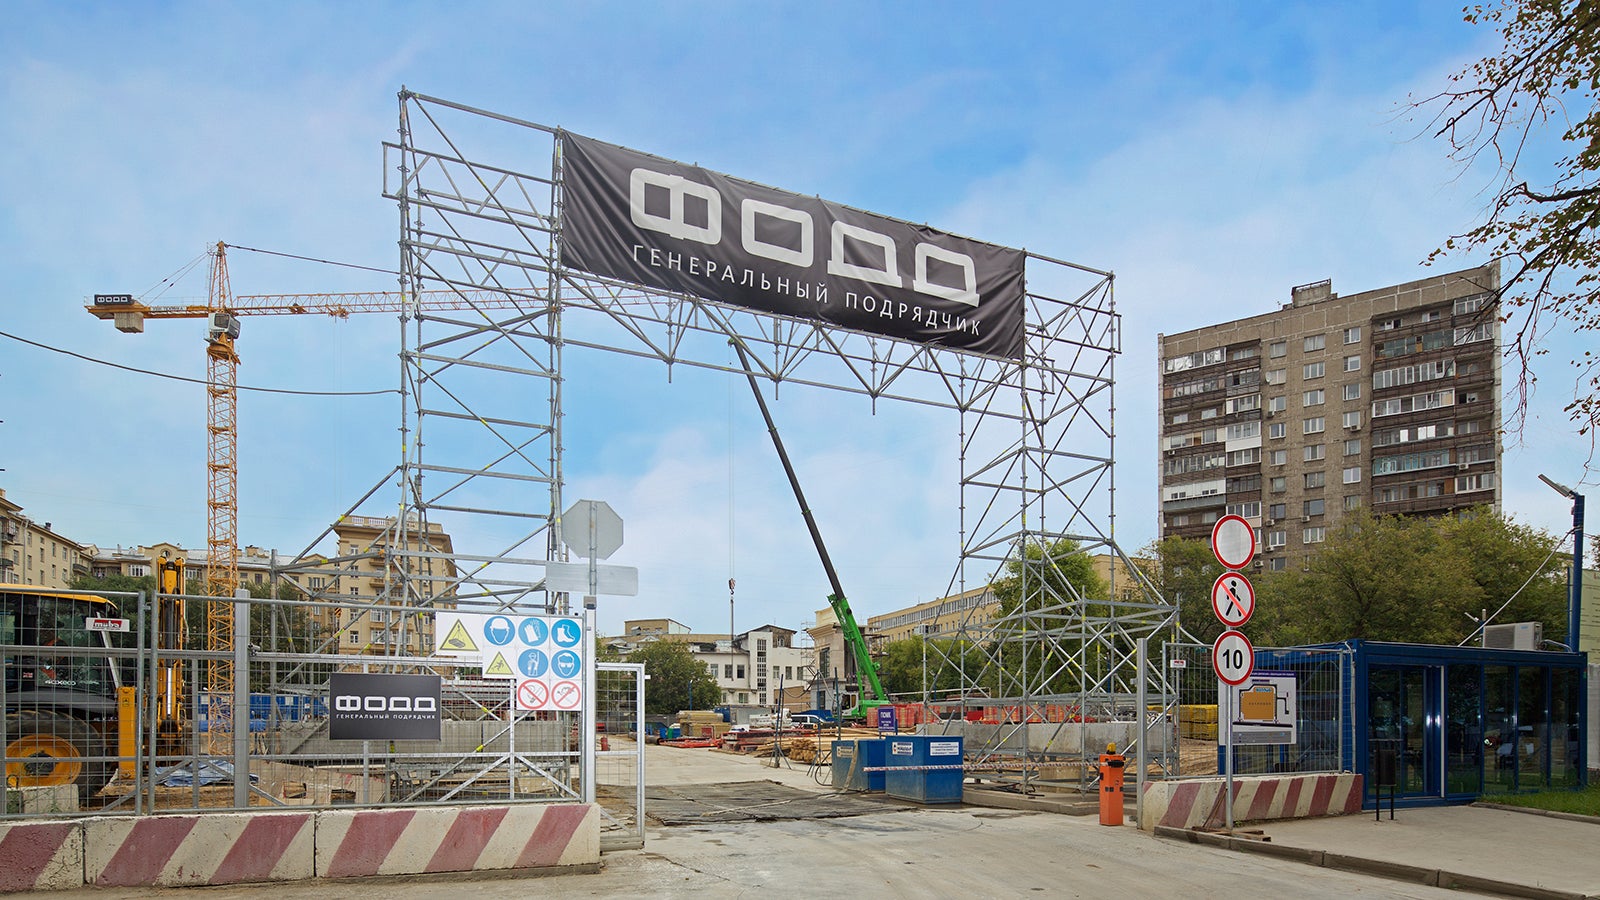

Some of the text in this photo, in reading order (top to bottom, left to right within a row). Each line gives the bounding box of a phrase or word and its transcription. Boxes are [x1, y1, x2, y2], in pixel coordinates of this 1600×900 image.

[629, 167, 981, 308] ФОДД
[633, 244, 982, 337] ГЕНЕРАЛЬНЫЙ ПОДРЯДЧИК
[1222, 648, 1243, 670] 10
[335, 695, 437, 712] ФОДД
